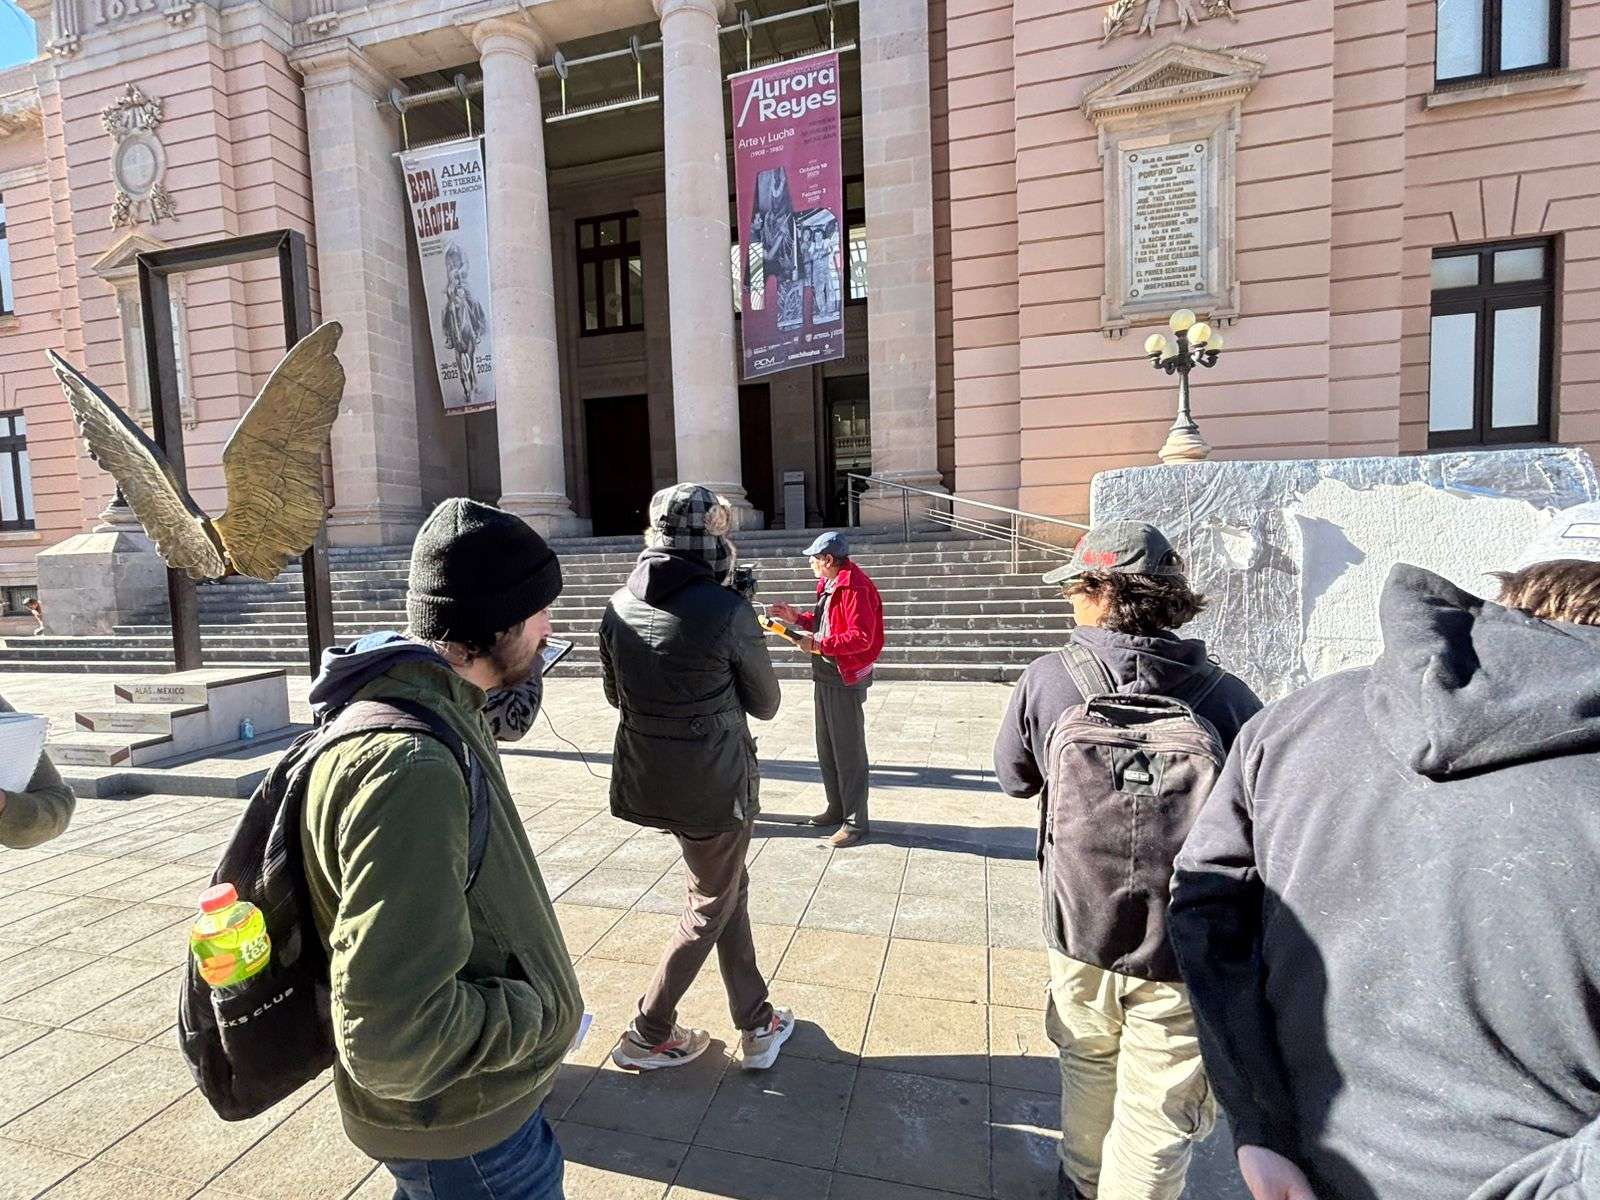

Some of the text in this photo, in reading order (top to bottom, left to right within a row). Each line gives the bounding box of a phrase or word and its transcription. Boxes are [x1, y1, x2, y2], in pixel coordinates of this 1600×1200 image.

[737, 67, 835, 128] Aurora
[760, 89, 837, 122] Reyes
[738, 138, 759, 149] Arte
[760, 136, 766, 145] y
[768, 128, 795, 143] Lucha
[441, 161, 481, 178] ALMA
[408, 168, 440, 204] BEDA
[442, 175, 482, 188] DE TIERRA
[442, 370, 459, 380] 2025
